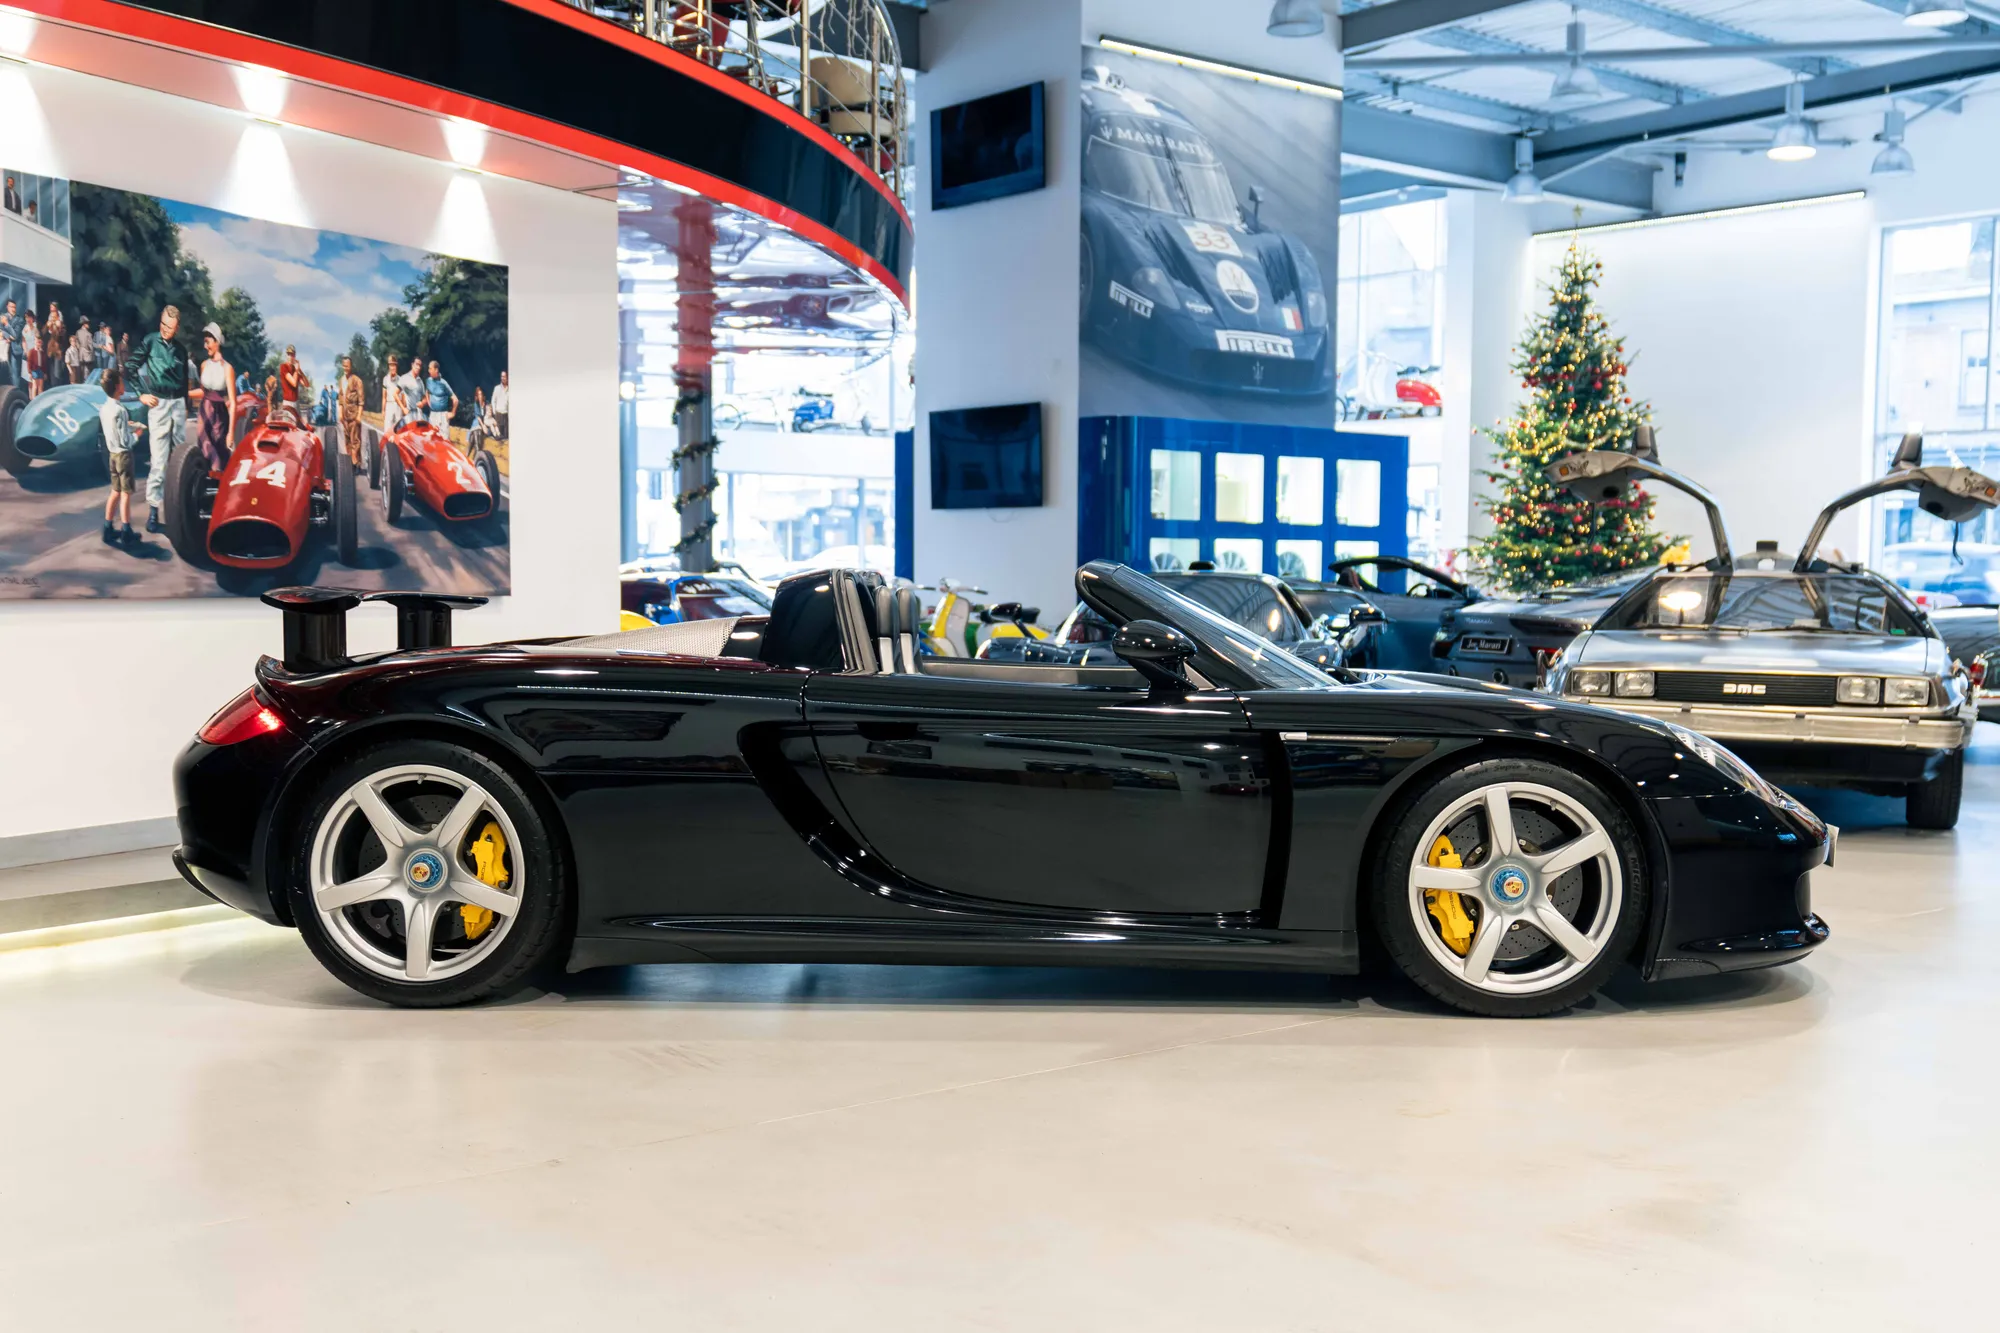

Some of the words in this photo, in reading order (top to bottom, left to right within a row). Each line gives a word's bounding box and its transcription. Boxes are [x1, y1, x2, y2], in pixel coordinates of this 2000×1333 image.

[1194, 231, 1230, 249] 33
[1215, 329, 1295, 358] PIRELLI
[46, 408, 80, 434] 18
[229, 459, 286, 488] 14
[447, 461, 472, 484] 2
[1467, 639, 1477, 648] Joe
[1480, 640, 1501, 649] Macari
